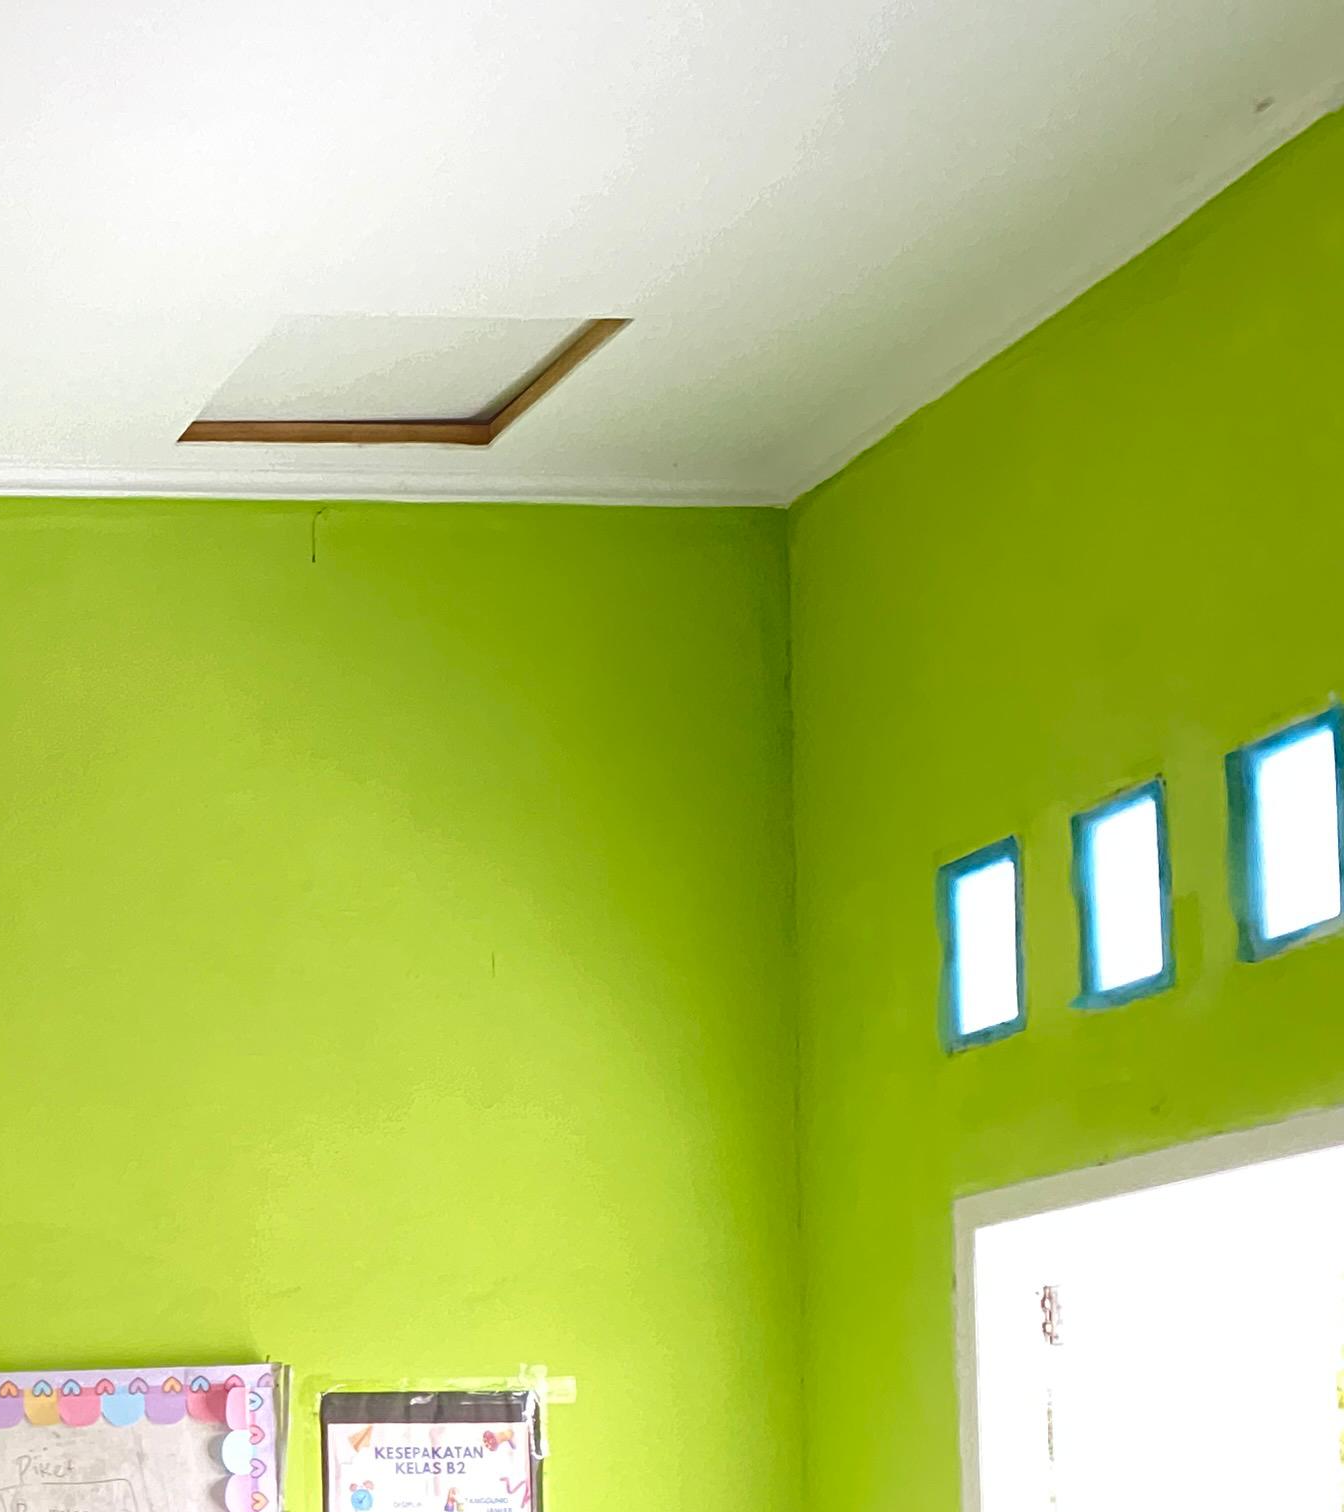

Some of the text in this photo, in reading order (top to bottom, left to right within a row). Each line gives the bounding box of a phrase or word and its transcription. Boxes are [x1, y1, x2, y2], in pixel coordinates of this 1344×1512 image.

[375, 1447, 484, 1460] KESEPAKATAN
[16, 1455, 74, 1486] Piket
[395, 1462, 466, 1475] KELAS B2
